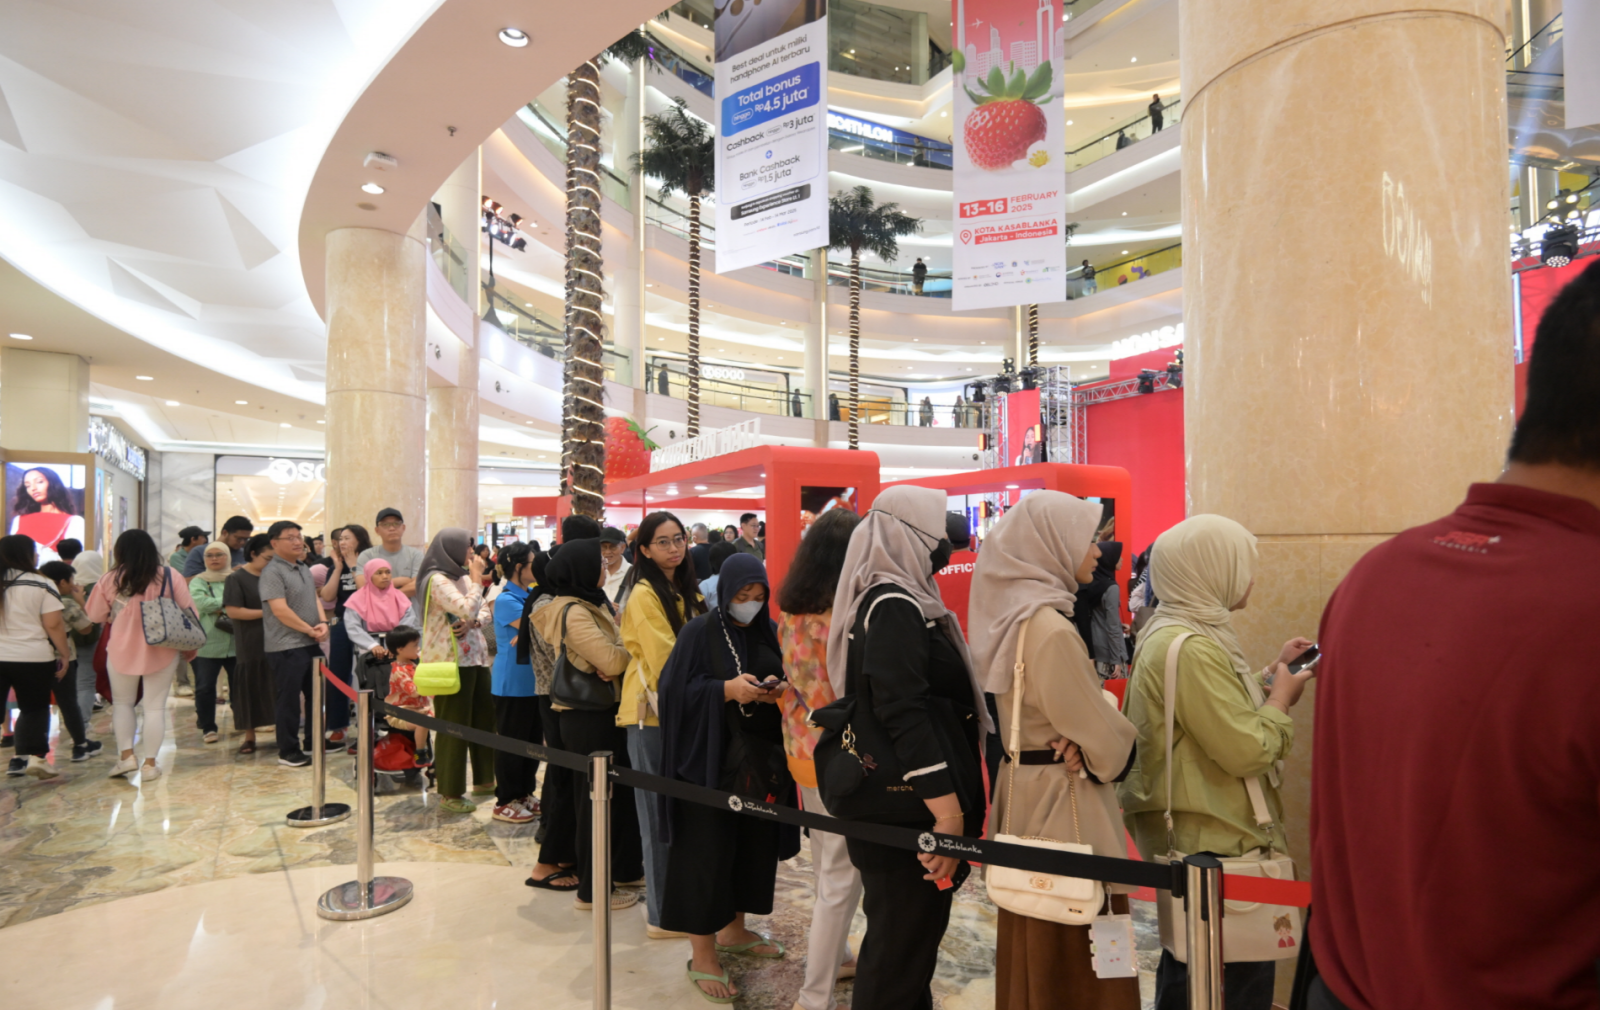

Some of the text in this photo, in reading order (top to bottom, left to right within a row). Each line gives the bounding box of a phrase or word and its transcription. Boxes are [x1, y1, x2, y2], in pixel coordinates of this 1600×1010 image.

[730, 46, 811, 84] handphone AI terbaru
[732, 34, 807, 73] Best deal untuk miliki
[738, 75, 801, 106] Total bonus
[726, 131, 765, 151] Cashback
[740, 155, 801, 181] Bank Cashback
[963, 190, 1058, 216] 13-16 FEBRUARY
[1011, 203, 1033, 213] 2025
[974, 218, 1057, 234] KOTA KASABLANKA
[979, 232, 1008, 243] Jakarta
[1015, 228, 1053, 239] Indonesia
